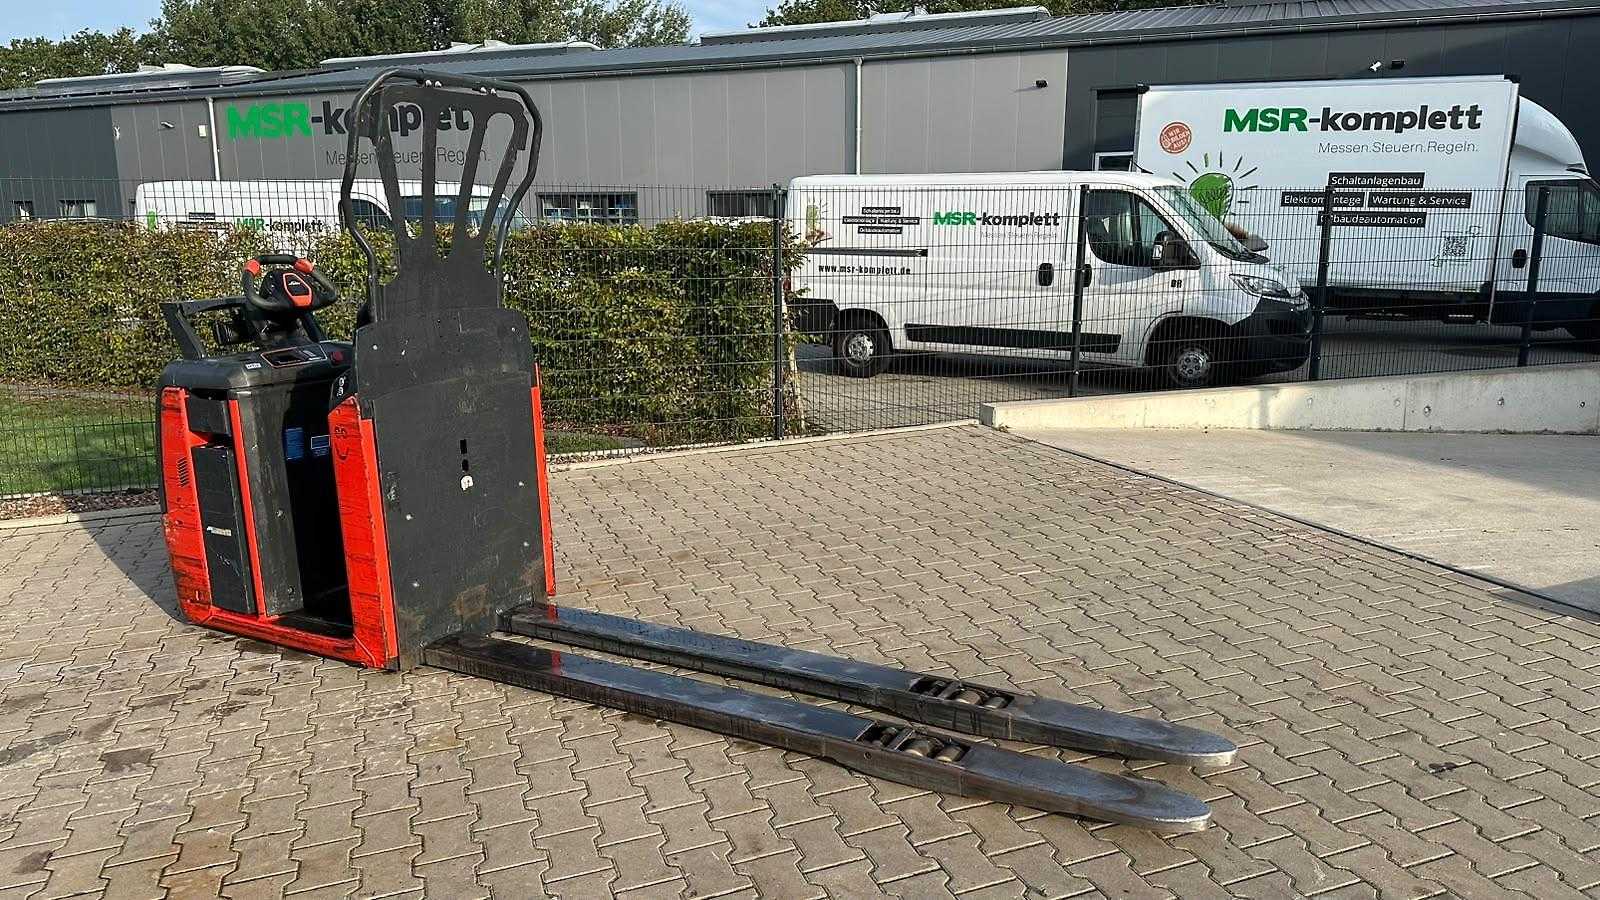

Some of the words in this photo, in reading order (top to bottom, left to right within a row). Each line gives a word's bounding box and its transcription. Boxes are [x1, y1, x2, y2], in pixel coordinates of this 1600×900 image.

[1223, 104, 1482, 133] MSR-komplett
[1331, 176, 1421, 187] Schaltanlagenbau
[1284, 195, 1361, 206] Elektromntage
[1372, 195, 1416, 207] Wartung
[1418, 196, 1427, 205] &
[1429, 195, 1467, 205] Service
[933, 211, 1060, 228] MSR-komplett
